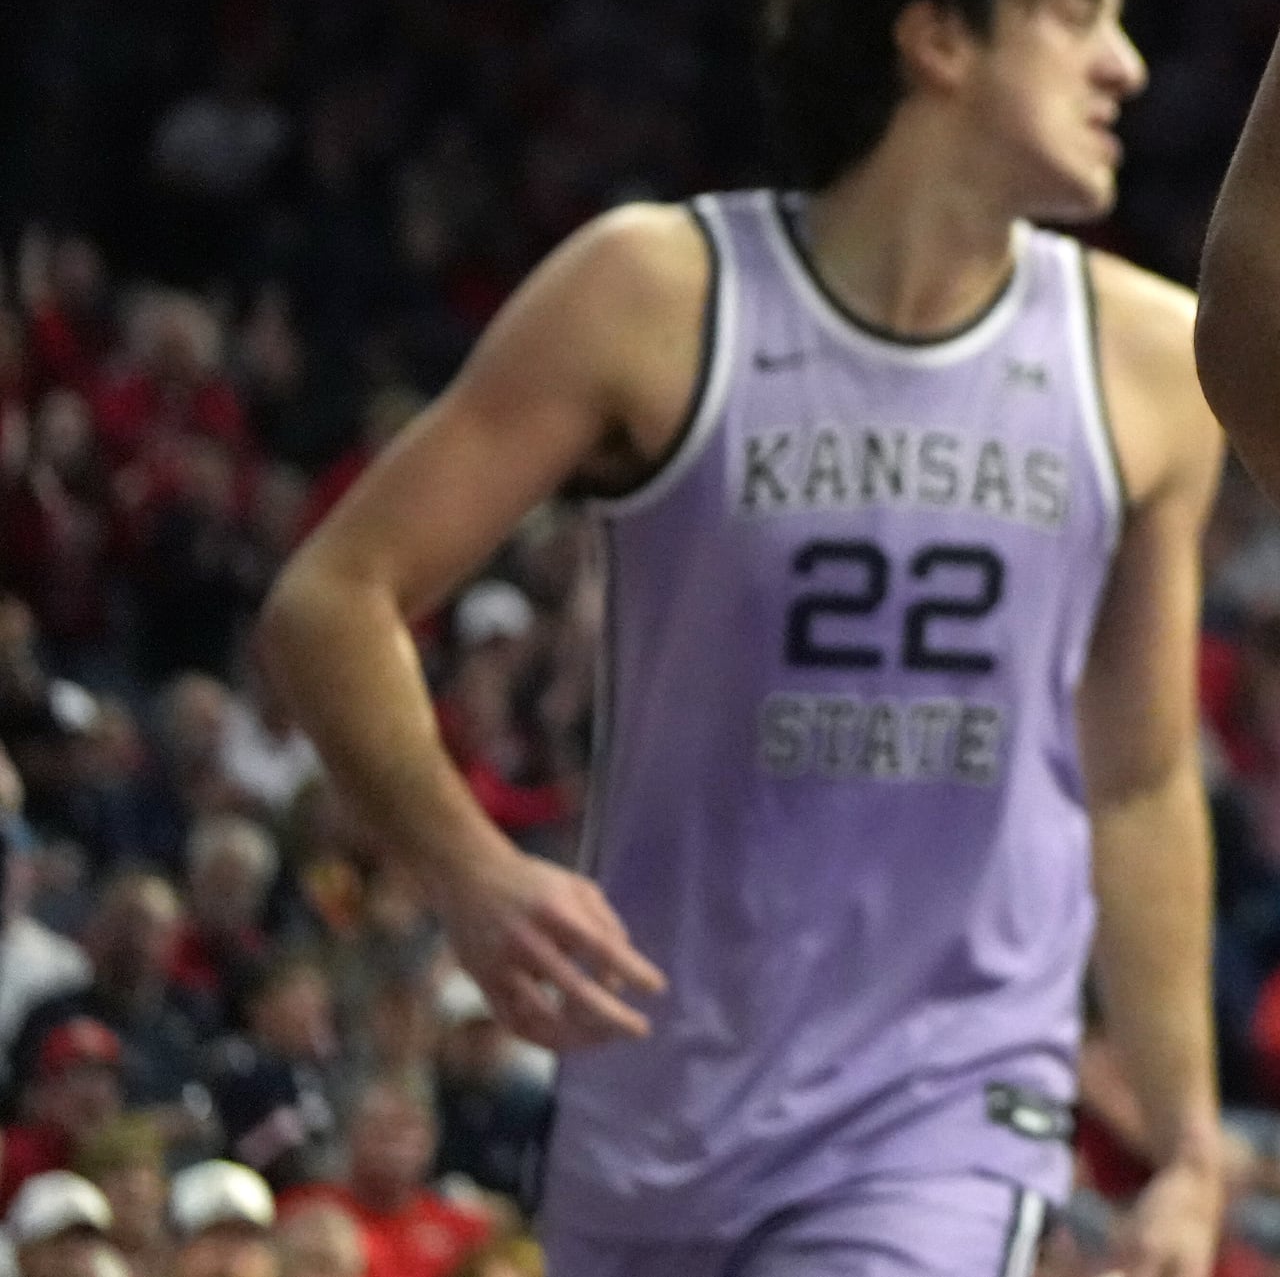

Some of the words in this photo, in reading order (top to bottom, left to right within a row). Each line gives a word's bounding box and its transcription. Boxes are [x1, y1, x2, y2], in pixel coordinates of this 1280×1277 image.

[735, 425, 1073, 525] KANSAS
[786, 539, 1004, 673] 22
[757, 693, 1002, 784] STATE
